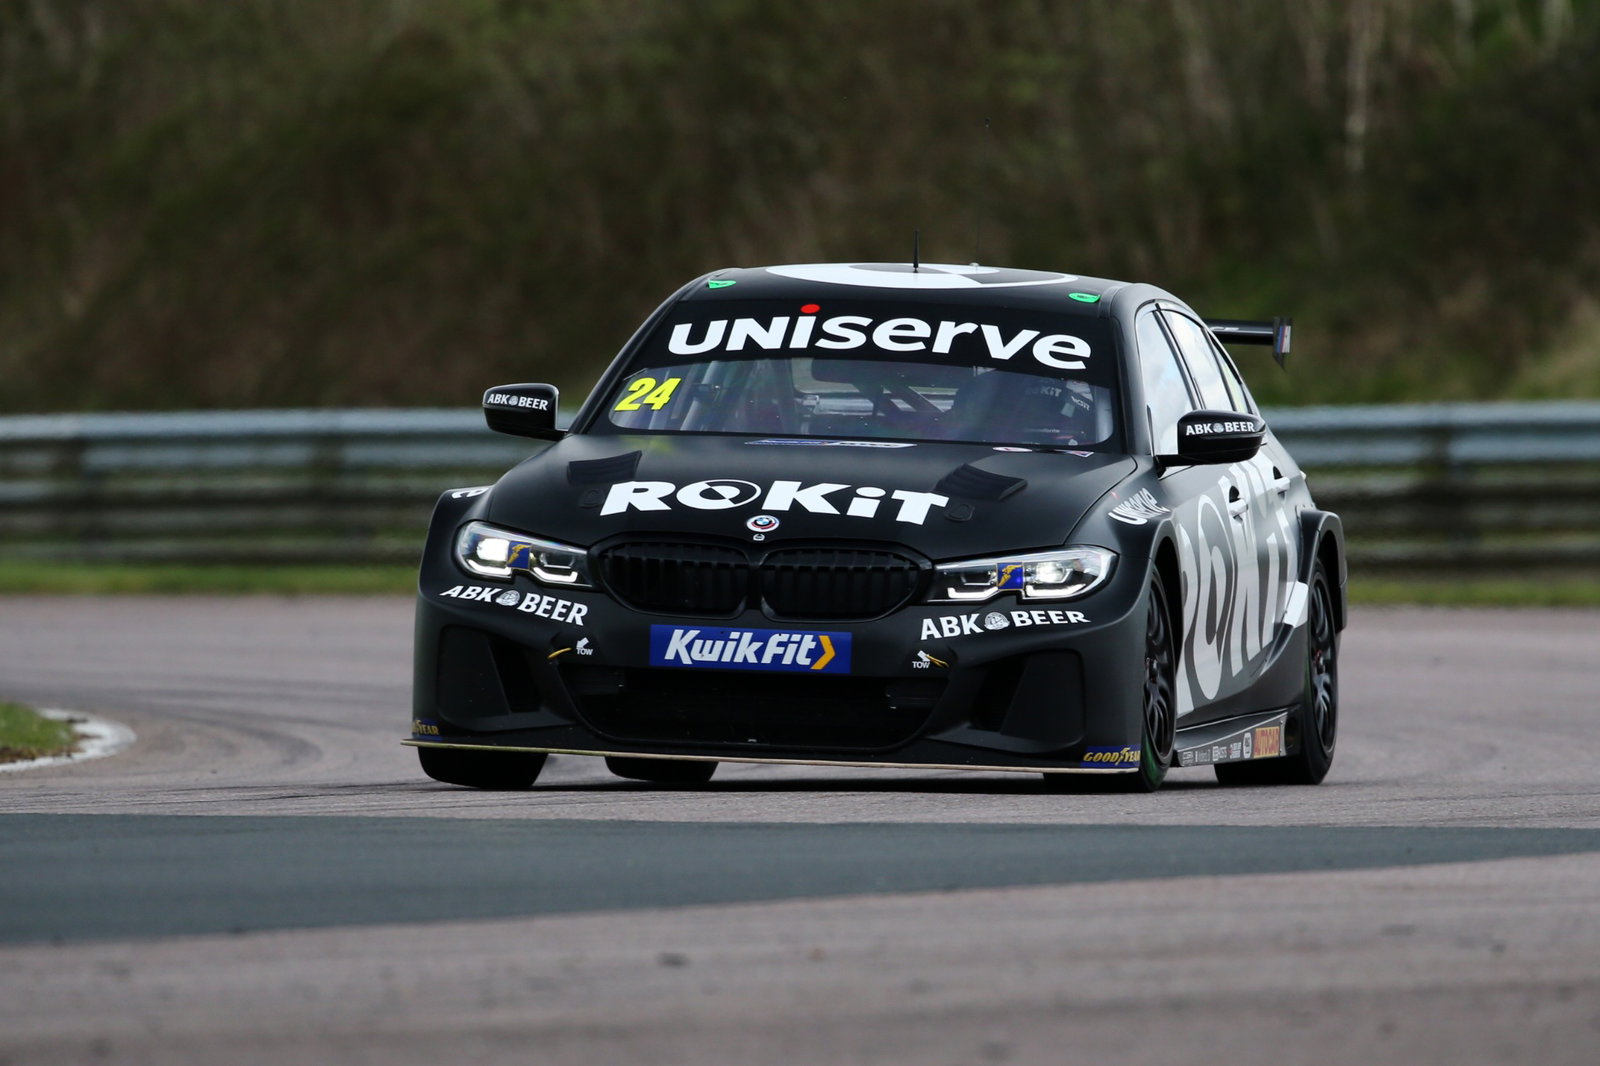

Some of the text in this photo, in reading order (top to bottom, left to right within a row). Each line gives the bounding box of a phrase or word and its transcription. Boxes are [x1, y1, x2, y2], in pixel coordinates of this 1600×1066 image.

[487, 393, 549, 411] ABK BEER
[614, 377, 682, 412] 24
[1186, 421, 1255, 436] ABK BEER
[440, 585, 588, 626] ABK BEER
[920, 610, 1092, 641] ABK BEER
[576, 647, 594, 656] TOW
[912, 660, 931, 669] TOW
